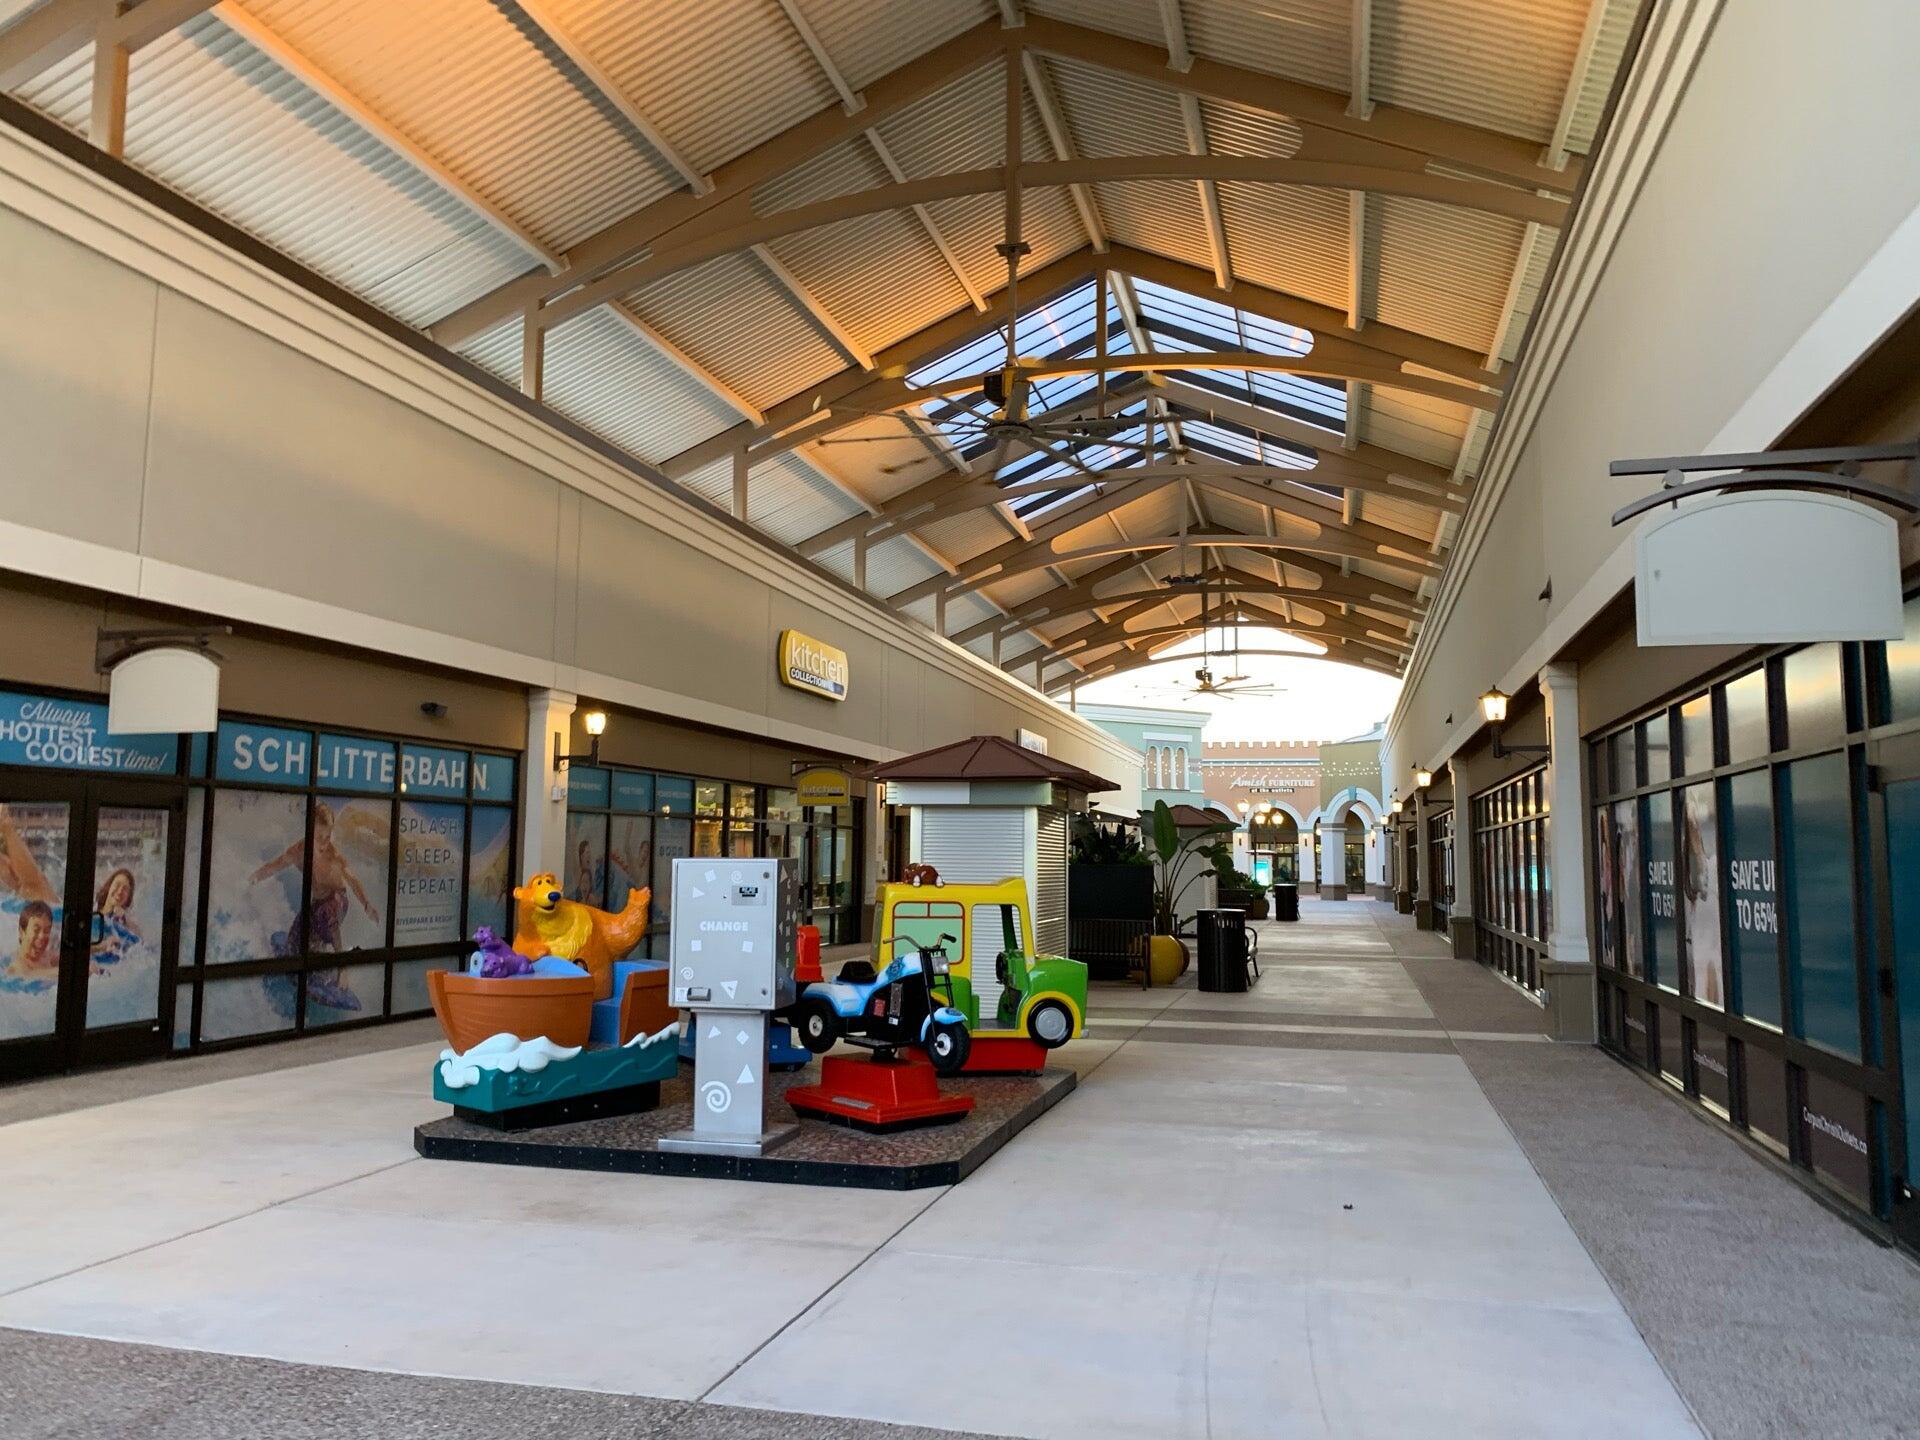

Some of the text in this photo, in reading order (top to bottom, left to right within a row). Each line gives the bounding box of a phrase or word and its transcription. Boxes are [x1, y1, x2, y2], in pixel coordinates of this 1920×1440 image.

[791, 637, 844, 683] kitchen
[20, 700, 91, 728] Always
[0, 718, 96, 747] HOTTEST
[26, 740, 167, 771] COOLEST time!
[1229, 776, 1316, 790] Amish FURNITURE
[1649, 861, 1674, 886] SAVE U
[1731, 860, 1776, 892] SAVE U
[1652, 892, 1662, 916] TO
[1736, 899, 1778, 934] TO 65%
[700, 920, 748, 931] CHANGE
